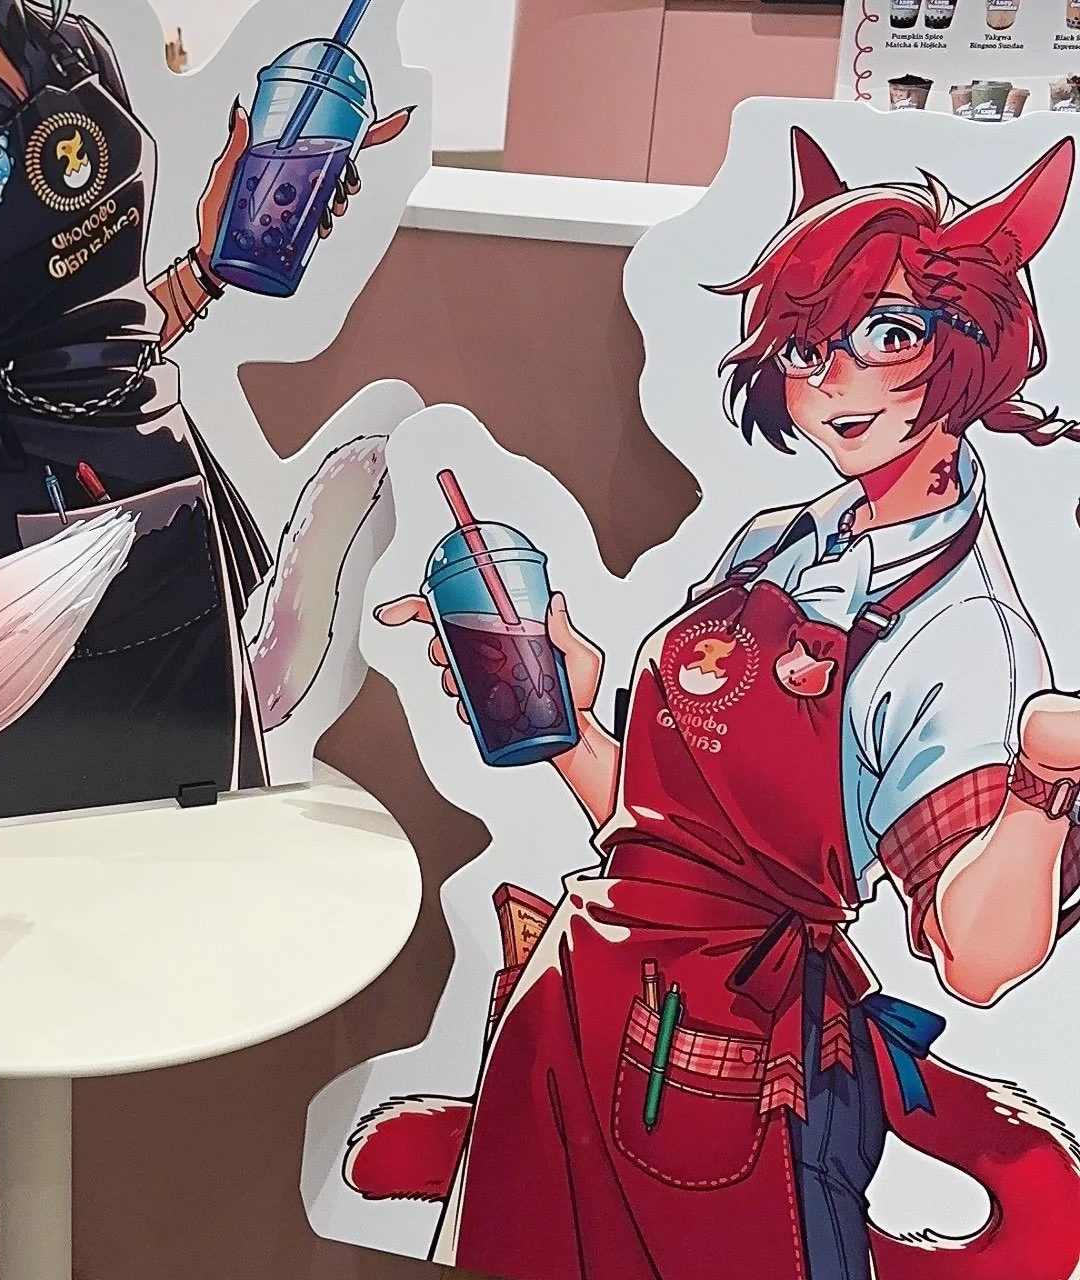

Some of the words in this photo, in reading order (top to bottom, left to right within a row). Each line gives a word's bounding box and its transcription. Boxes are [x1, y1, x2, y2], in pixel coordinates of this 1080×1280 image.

[891, 32, 923, 41] Pumpkin
[924, 32, 944, 41] Spice
[885, 41, 911, 49] Matcha
[920, 41, 947, 50] Hojicha
